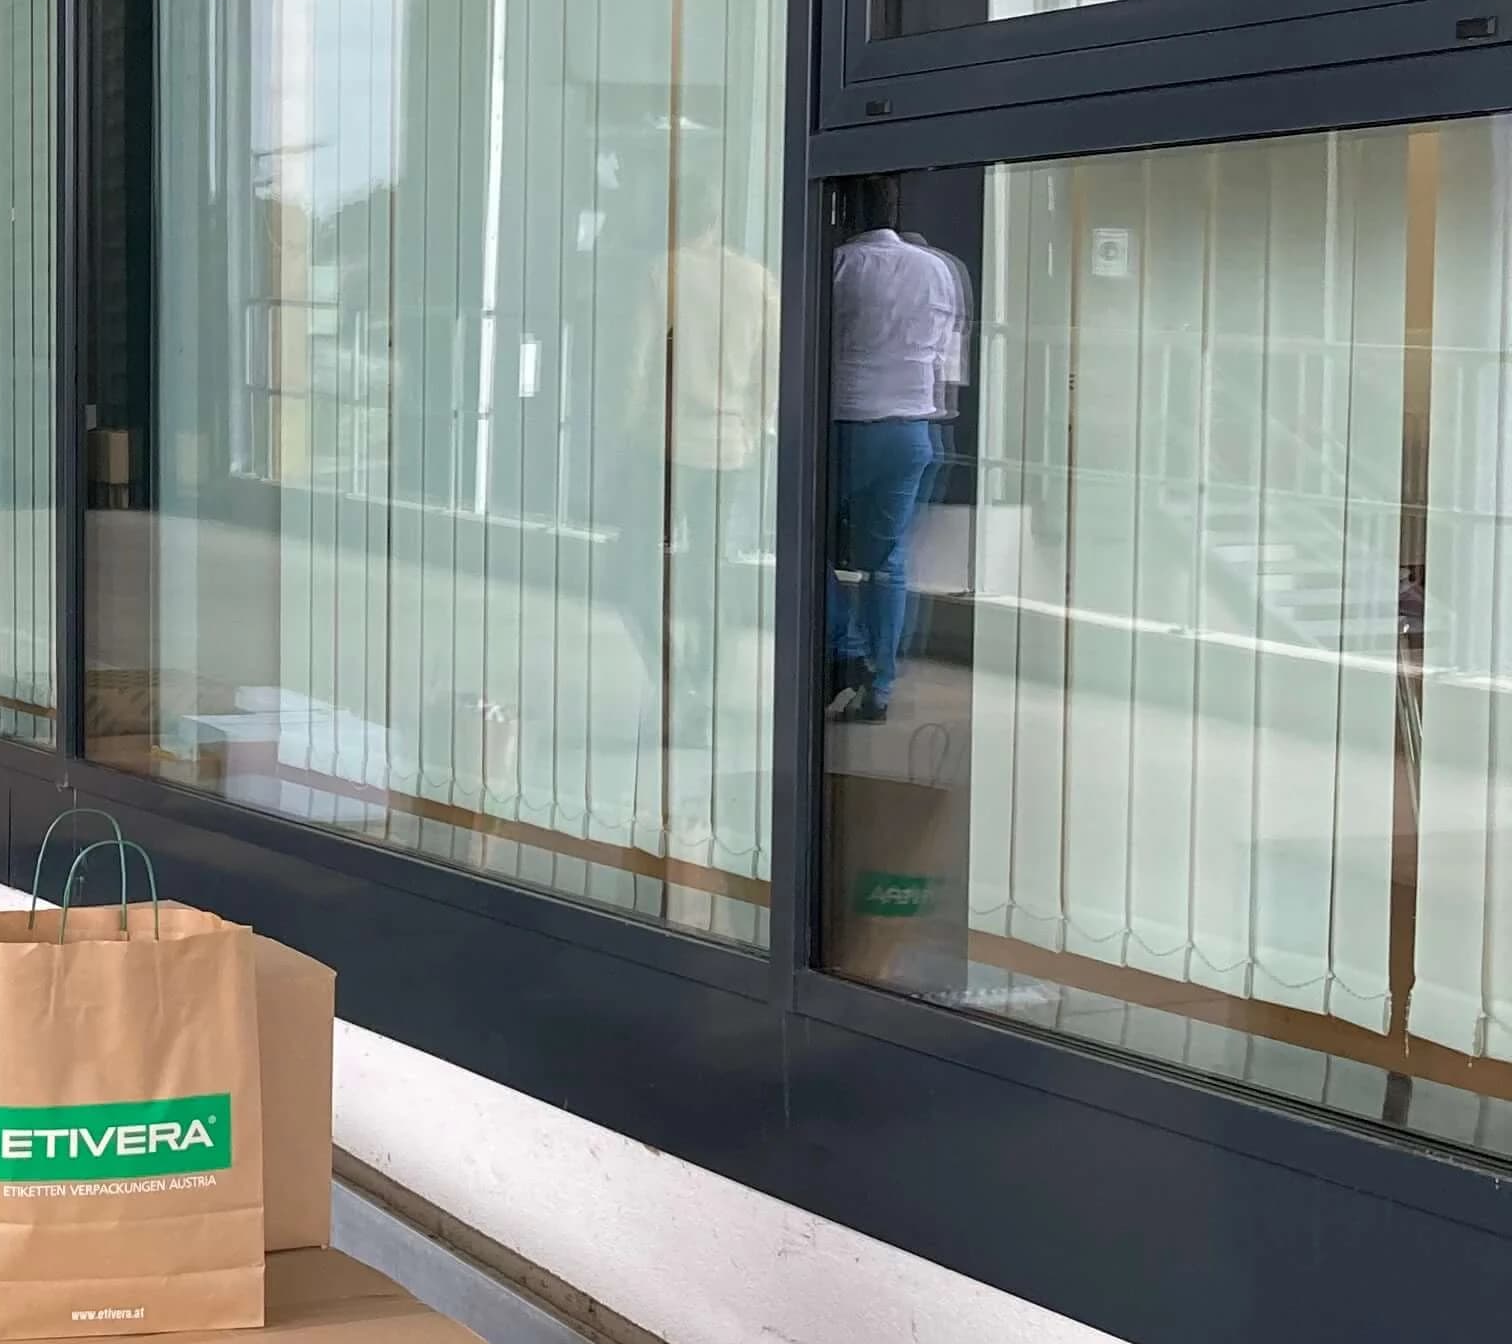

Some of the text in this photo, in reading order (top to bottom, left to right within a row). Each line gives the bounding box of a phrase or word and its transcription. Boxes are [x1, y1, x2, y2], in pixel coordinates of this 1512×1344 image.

[3, 1174, 217, 1198] ETIKETTEN VERPACKUNGEN AUSTRIA
